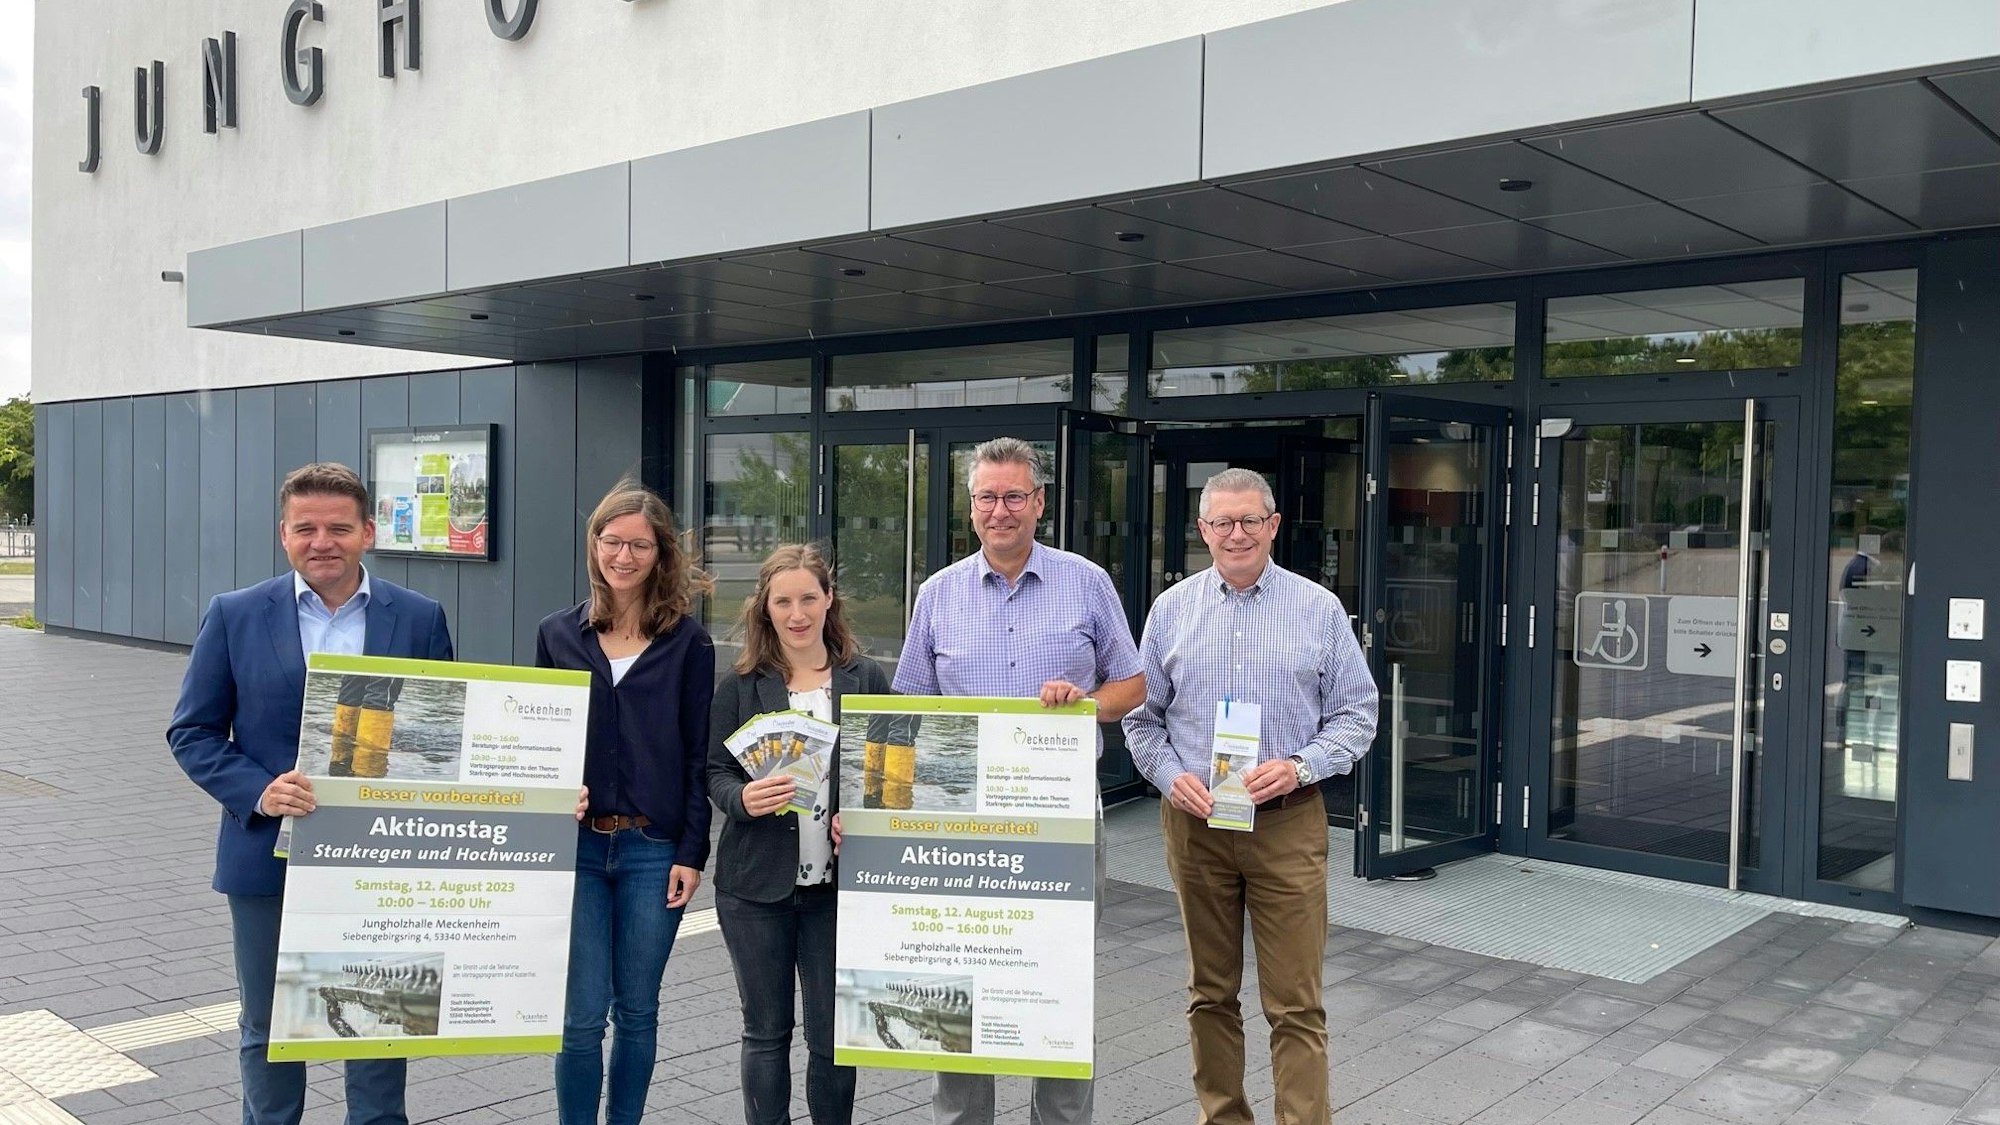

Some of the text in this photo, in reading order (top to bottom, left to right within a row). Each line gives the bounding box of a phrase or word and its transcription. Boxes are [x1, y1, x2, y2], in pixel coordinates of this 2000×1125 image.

[1689, 628, 1713, 636] Schalter
[1715, 630, 1737, 638] drücke
[471, 741, 499, 751] Beratungs-
[512, 744, 562, 753] Informationsstände
[469, 762, 519, 771] Vortragsprogramm
[469, 770, 499, 778] Starkregen-
[512, 772, 559, 780] Hochwasserschutz
[986, 773, 1011, 781] Beratungs-
[359, 786, 524, 805] Besser vorbereitet!
[985, 793, 1032, 801] Vortragsprogramm
[369, 816, 508, 845] Aktionstag
[889, 818, 1039, 835] Besser vorbereitet!
[313, 843, 556, 864] Starkregen und Hochwasser
[901, 846, 1025, 874] Aktionstag
[354, 879, 515, 895] Samstag, 12. August 2023
[856, 870, 1071, 892] Starkregen und Hochwasser
[377, 897, 414, 908] 10:00
[430, 898, 465, 909] 16:00
[469, 898, 492, 909] Uhr
[891, 904, 1034, 921] Samstag, 12. August 2023
[362, 918, 500, 930] Jungholzhalle Meckenheim
[911, 922, 944, 932] 10:00
[957, 924, 989, 934] 16:00
[992, 924, 1014, 936] Uhr
[342, 932, 517, 943] Siebengebirgsring 4, 53340 Meckenheim
[900, 941, 1023, 956] Jungholzhalle Meckenheim
[884, 952, 1039, 968] Siebengebirgsring 4, 53340 Meckenheim
